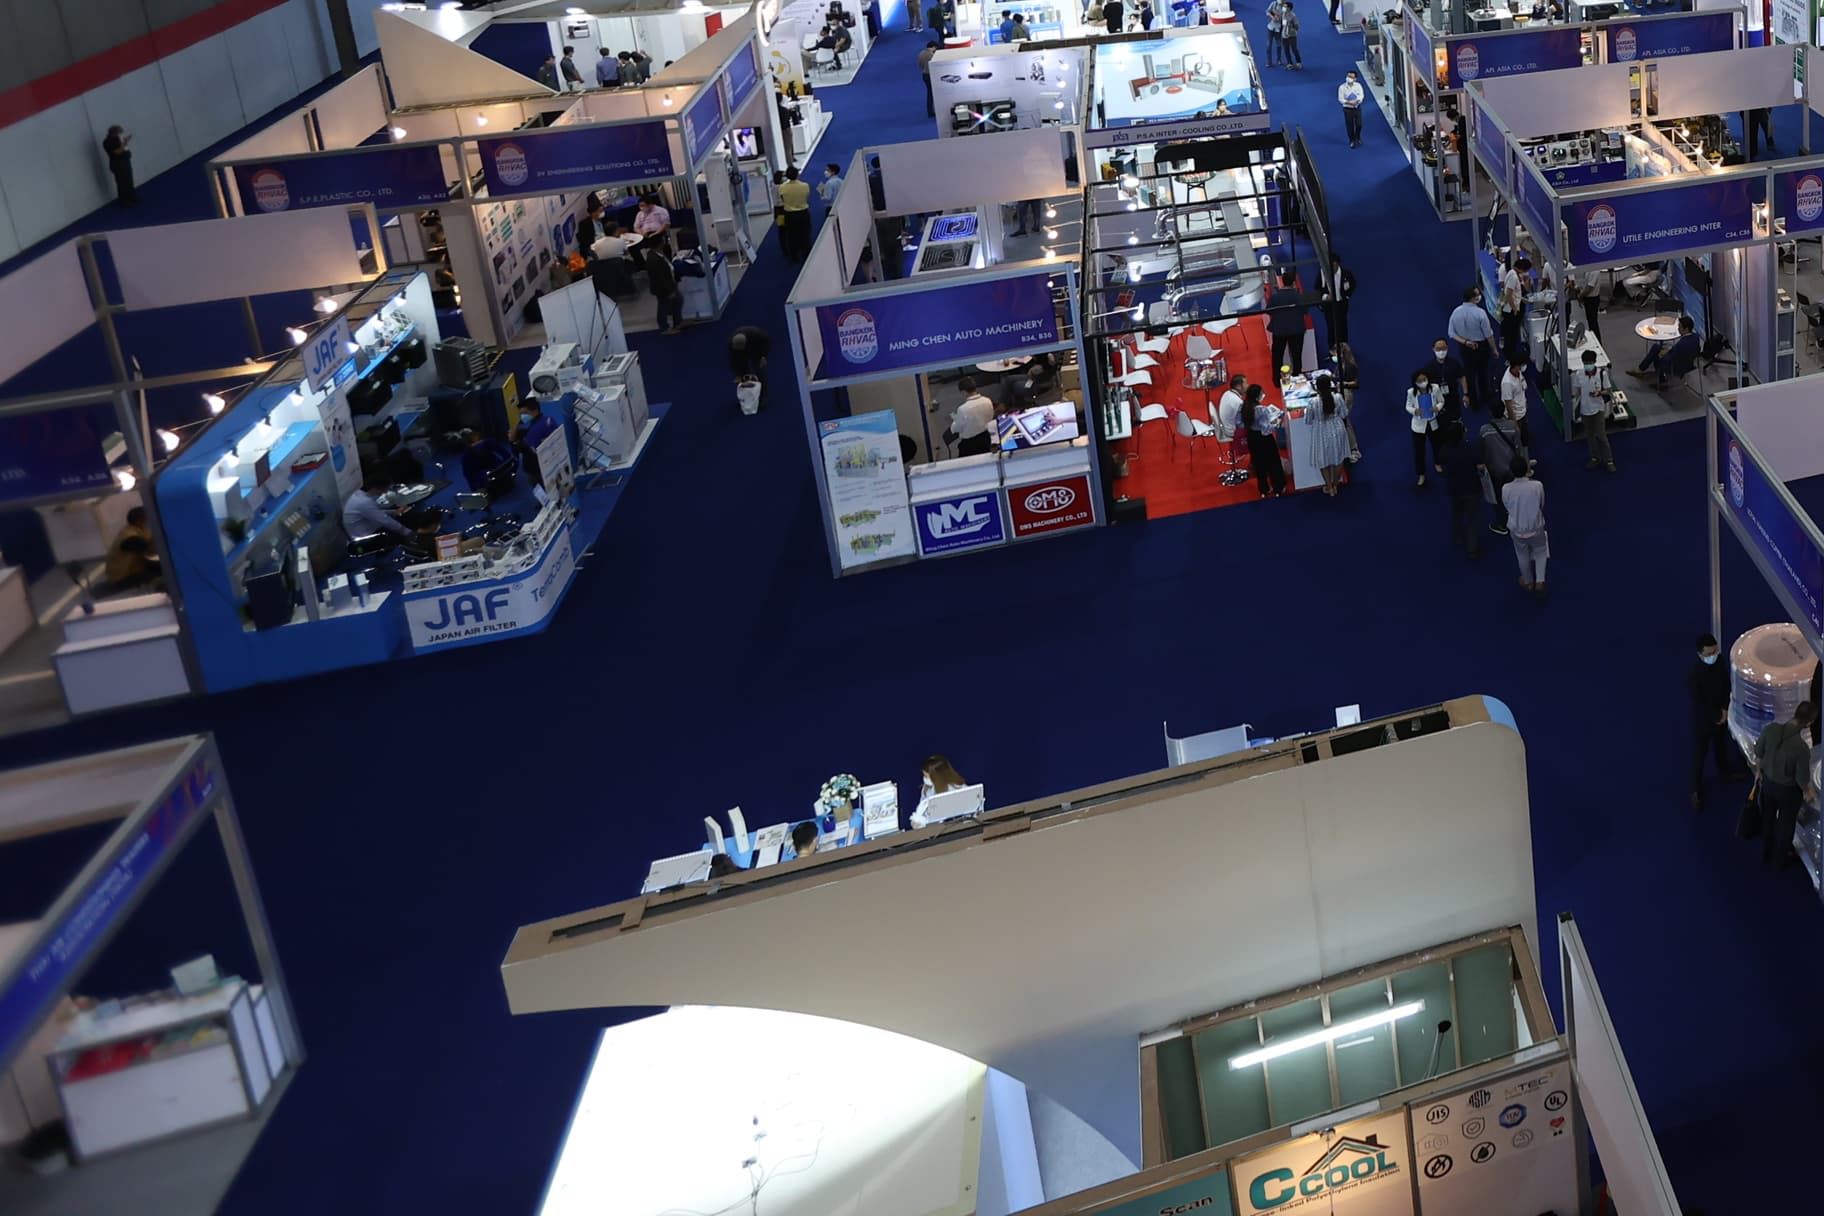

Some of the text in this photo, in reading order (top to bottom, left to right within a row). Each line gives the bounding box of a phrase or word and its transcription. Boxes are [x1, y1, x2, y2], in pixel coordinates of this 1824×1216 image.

[1183, 125, 1215, 135] COOLING
[595, 162, 632, 172] SOLUTIONS
[1623, 221, 1722, 243] UTILE ENGINEERING INTER
[841, 334, 876, 347] RHVAC
[889, 319, 1044, 352] MING CHEN AUTO MACHINERY
[313, 330, 338, 375] JAF
[1033, 516, 1064, 528] MACHINERY
[424, 587, 511, 630] JAF
[429, 621, 517, 642] JAPAN AIR FILTER
[1549, 1095, 1562, 1106] UL
[1428, 1107, 1446, 1122] JIS
